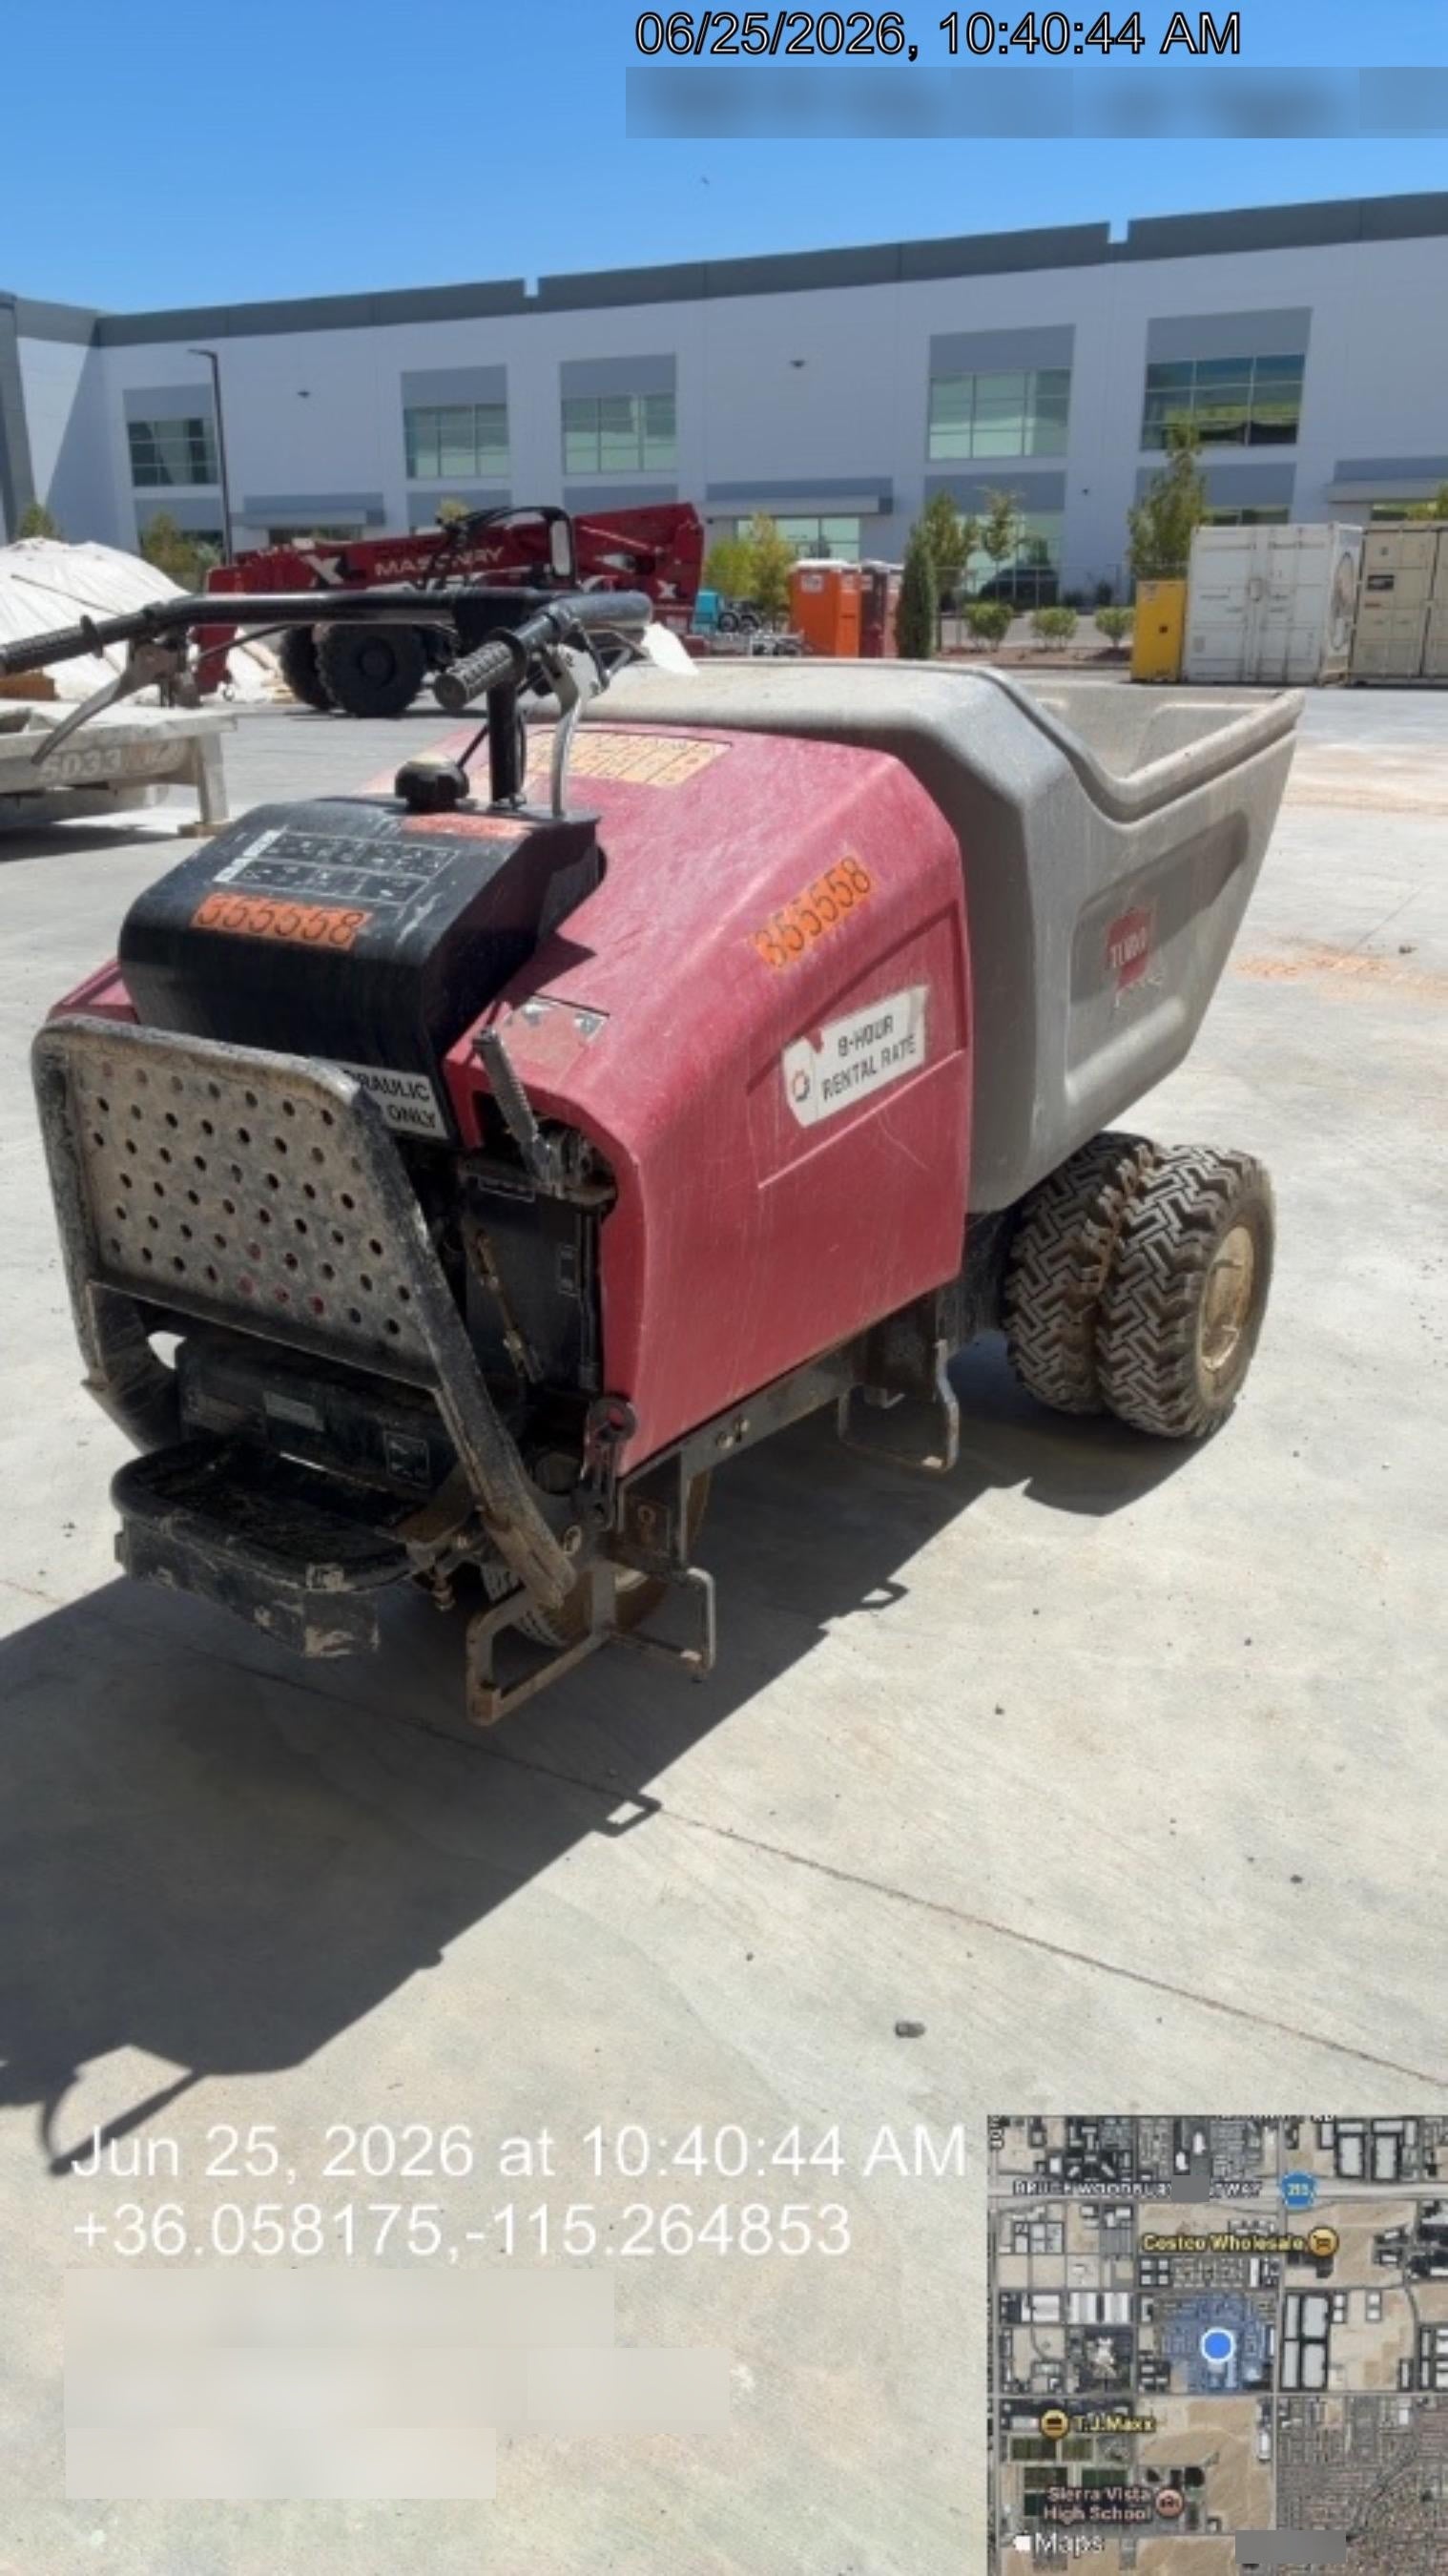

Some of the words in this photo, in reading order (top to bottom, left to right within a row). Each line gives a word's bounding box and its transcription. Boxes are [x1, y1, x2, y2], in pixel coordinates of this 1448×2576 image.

[838, 1014, 894, 1057] 8-HOUR
[821, 1054, 878, 1103] RENTAL
[880, 1032, 917, 1068] RATE
